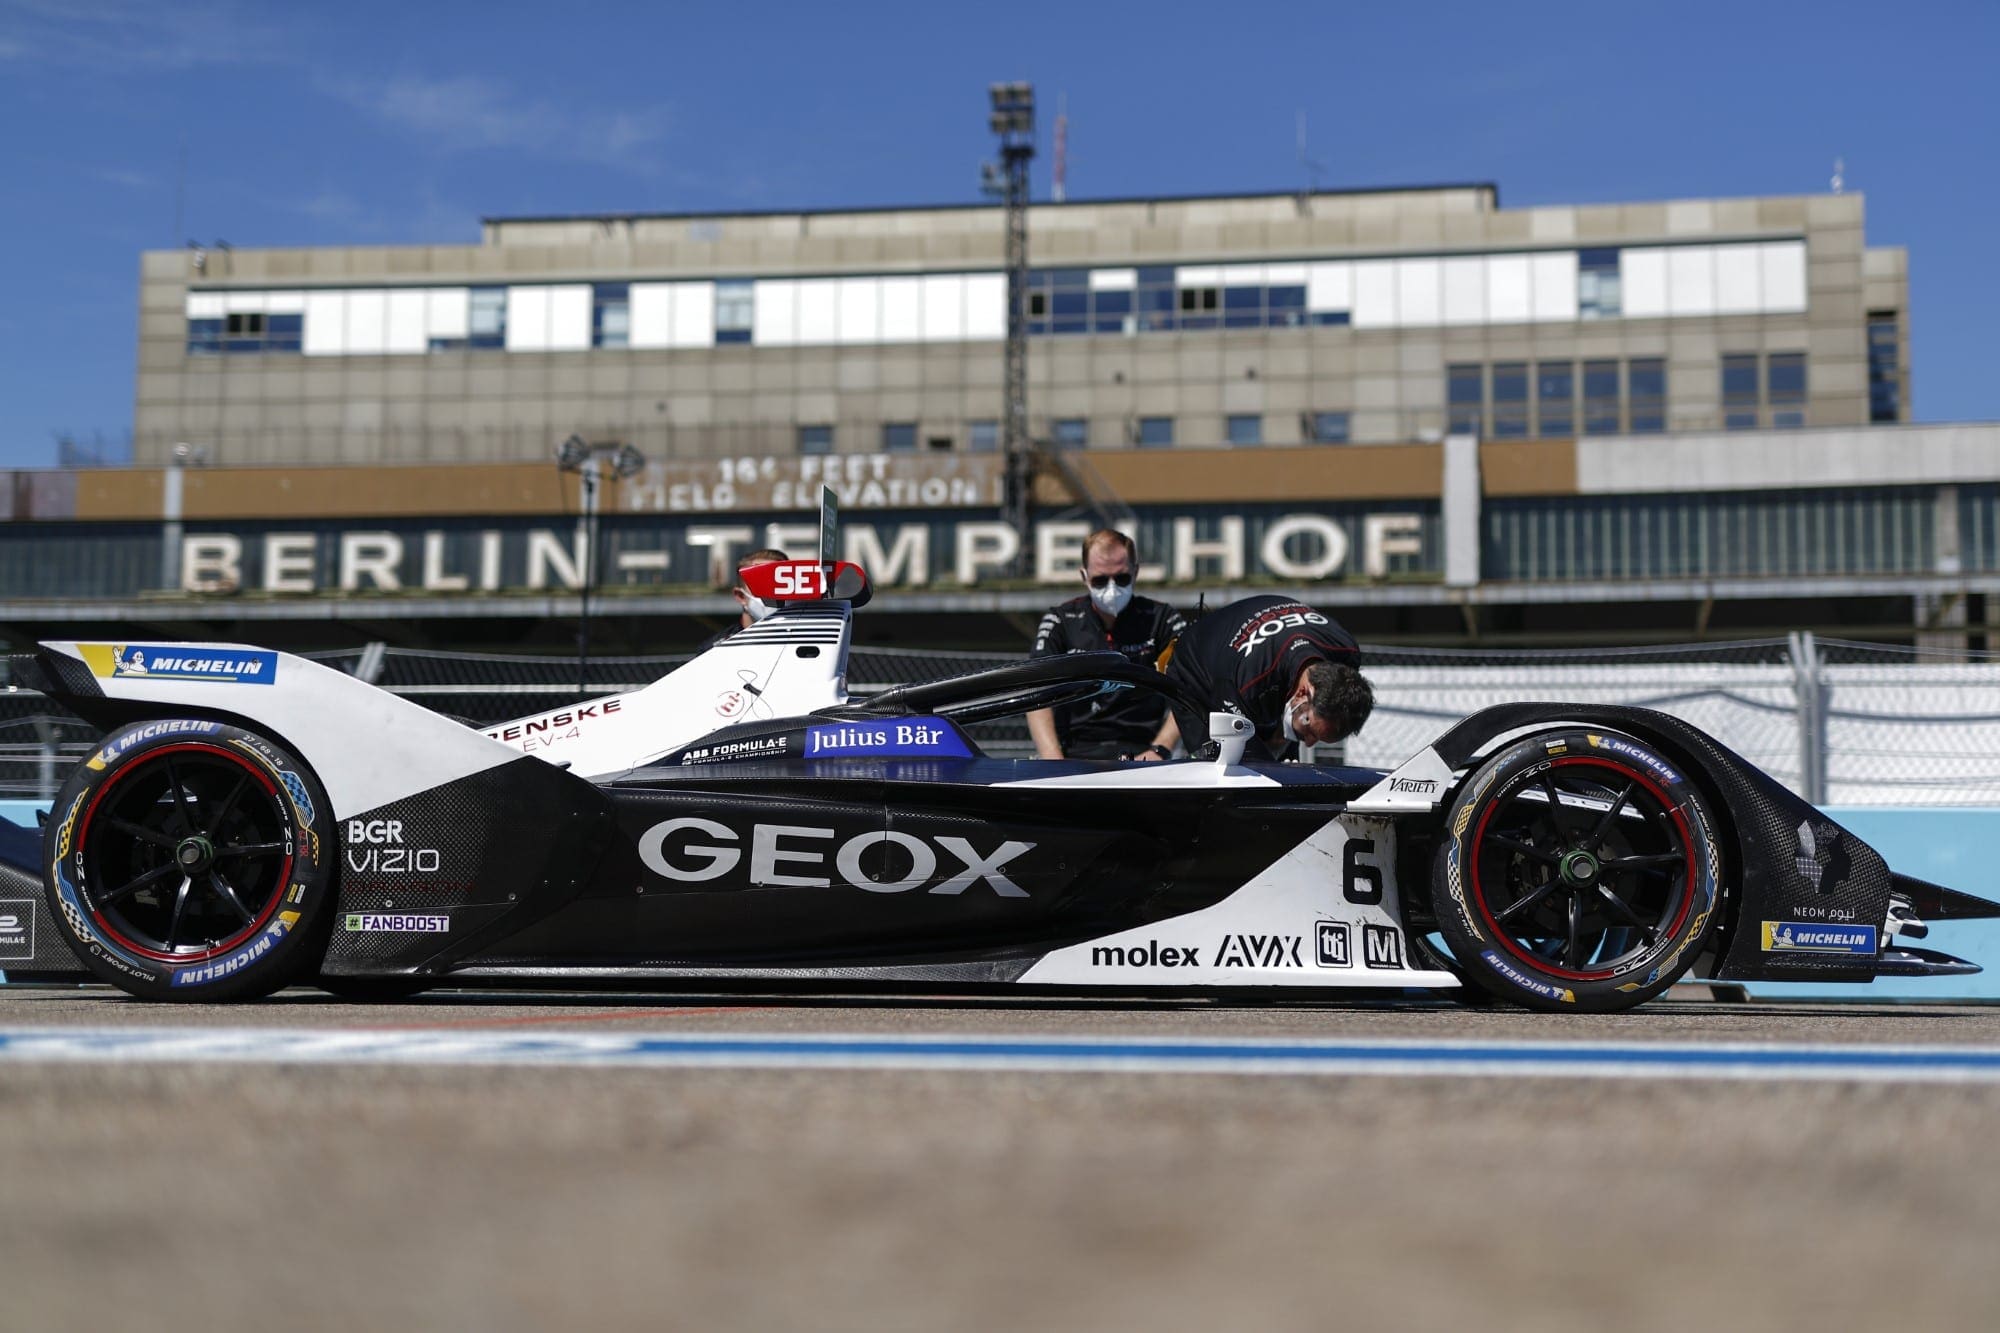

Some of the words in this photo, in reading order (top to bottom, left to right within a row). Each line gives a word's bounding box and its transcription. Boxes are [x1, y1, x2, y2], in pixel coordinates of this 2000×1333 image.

[801, 454, 891, 482] FEET
[772, 477, 977, 508] ELVATION
[183, 530, 588, 593] BERLIN
[774, 565, 832, 594] SET
[1237, 612, 1329, 657] GEOX
[151, 657, 263, 675] MICHELIN
[120, 720, 215, 750] MICHELIN
[523, 726, 580, 752] EV-4
[812, 729, 887, 752] Julius
[895, 725, 944, 746] Bär
[682, 748, 709, 761] ABB
[1612, 742, 1677, 780] MICHELIN
[1389, 777, 1441, 794] VARIETY
[348, 820, 404, 843] BGR
[348, 849, 439, 873] VIZIO
[638, 816, 1038, 898] GEOX
[1343, 838, 1383, 906] 6
[349, 916, 448, 931] #FANBOOST
[1793, 906, 1825, 917] NEOM
[1828, 907, 1855, 921] نيوم
[1367, 929, 1398, 964] M
[1796, 932, 1866, 945] MICHELIN
[102, 952, 130, 972] SPORT
[181, 935, 272, 984] MICHELIN
[1092, 939, 1200, 967] molex
[130, 968, 156, 982] PILOT
[1487, 954, 1550, 995] MICHELIN
